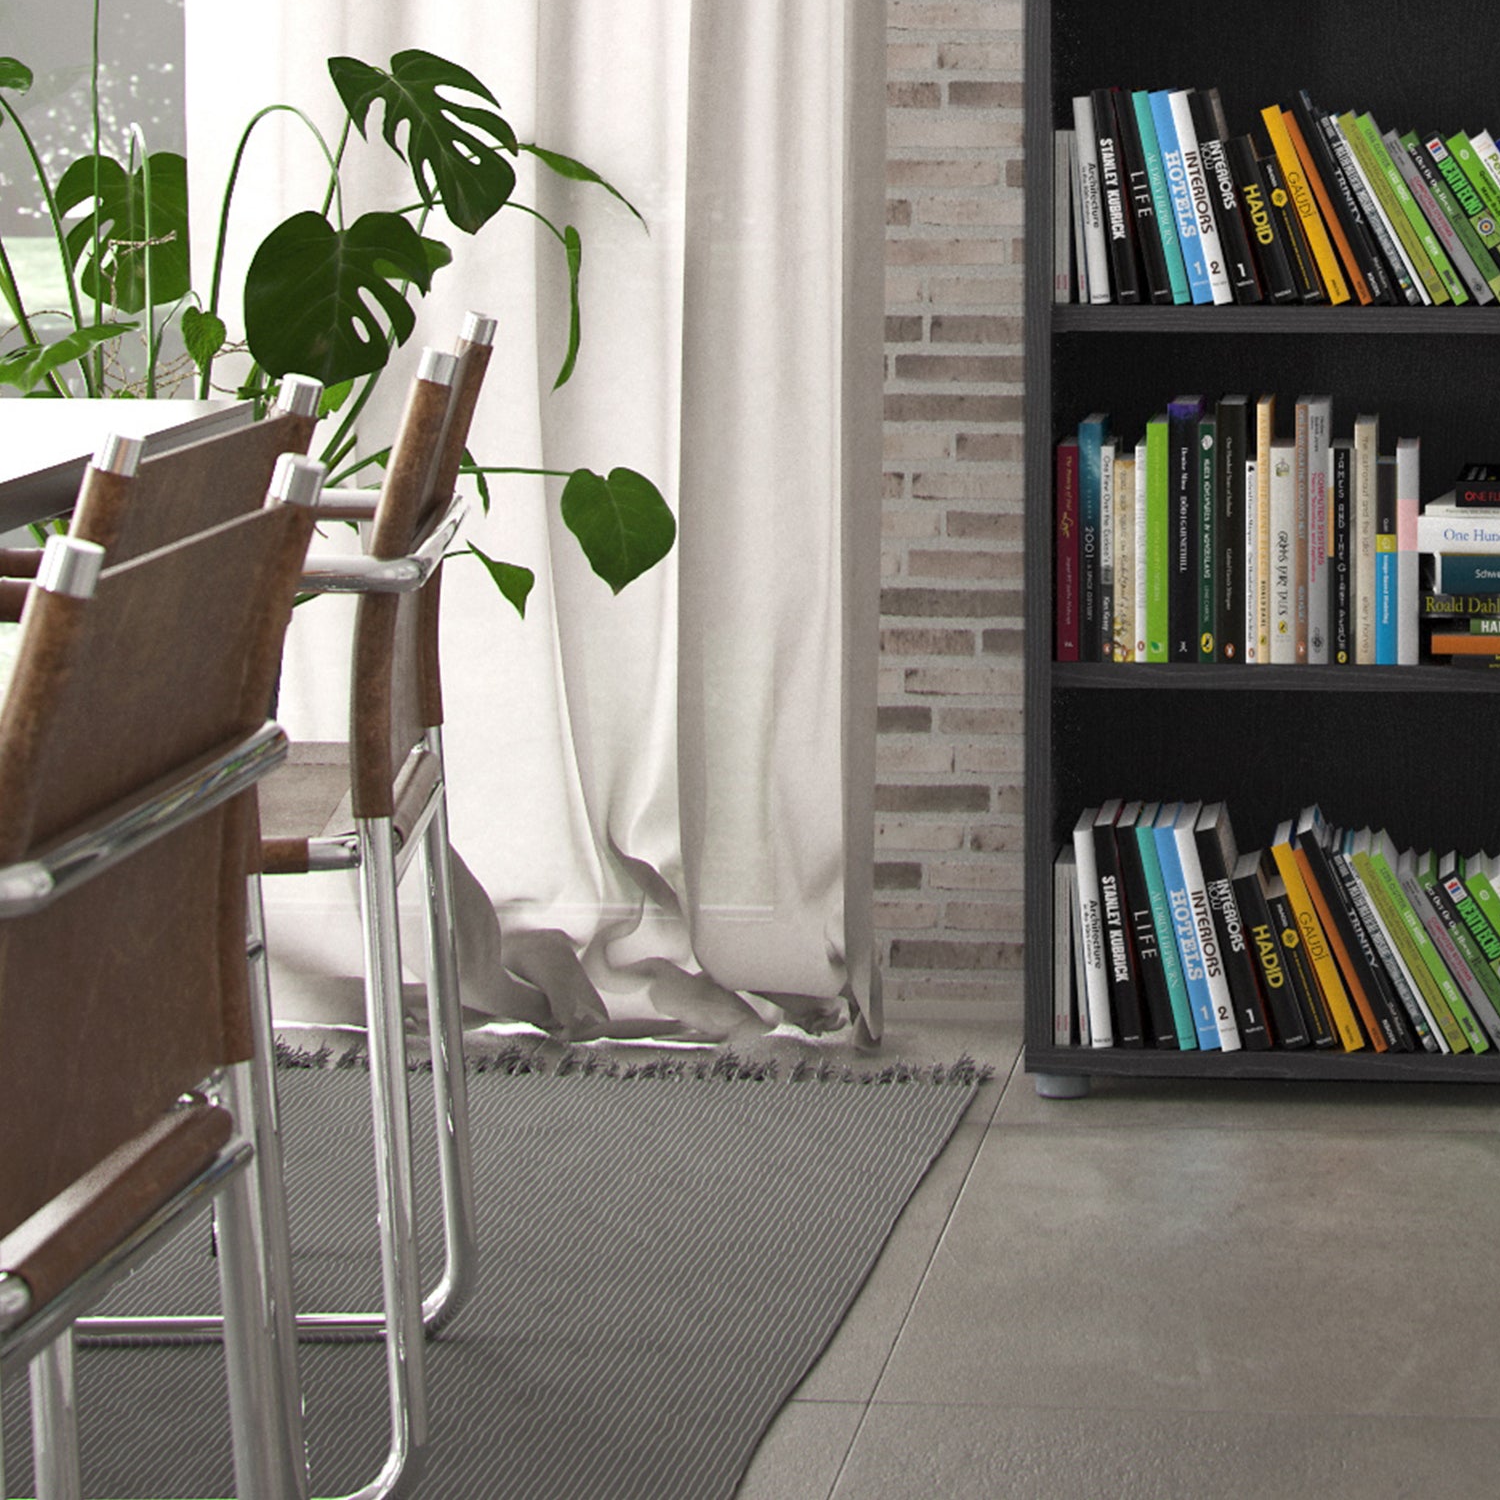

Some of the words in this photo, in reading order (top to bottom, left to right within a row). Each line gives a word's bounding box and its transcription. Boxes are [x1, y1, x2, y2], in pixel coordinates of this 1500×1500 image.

[1098, 137, 1118, 187] STANLEY
[1436, 154, 1468, 194] DEATH
[1454, 186, 1483, 218] ECHO
[1086, 161, 1102, 228] Architecture
[1105, 188, 1126, 240] KUBRICK
[1129, 169, 1153, 219] LIFE
[1164, 149, 1196, 238] HOTELS
[1183, 149, 1215, 235] INTERIORS
[1208, 259, 1221, 275] 2
[1206, 138, 1237, 211] INTERIORS
[1235, 262, 1248, 278] 1
[1242, 182, 1274, 246] HADID
[1287, 171, 1317, 220] GAUDÍ
[1333, 167, 1364, 227] TRINITY
[1084, 525, 1094, 559] 2001
[1443, 529, 1471, 542] One
[1425, 596, 1465, 613] Roald
[1468, 597, 1500, 614] Dahl
[1099, 874, 1121, 926] STANLEY
[1454, 895, 1488, 937] DEATH
[1087, 900, 1104, 970] Architecture
[1108, 928, 1130, 982] KUBRICK
[1133, 908, 1157, 960] LIFE
[1169, 887, 1203, 981] HOTELS
[1189, 888, 1223, 978] INTERIORS
[1216, 1004, 1229, 1020] 2
[1214, 876, 1246, 952] INTERIORS
[1244, 1006, 1257, 1023] 1
[1251, 923, 1285, 990] HADID
[1299, 911, 1330, 963] GAUDÍ
[1346, 910, 1379, 970] TRINITY
